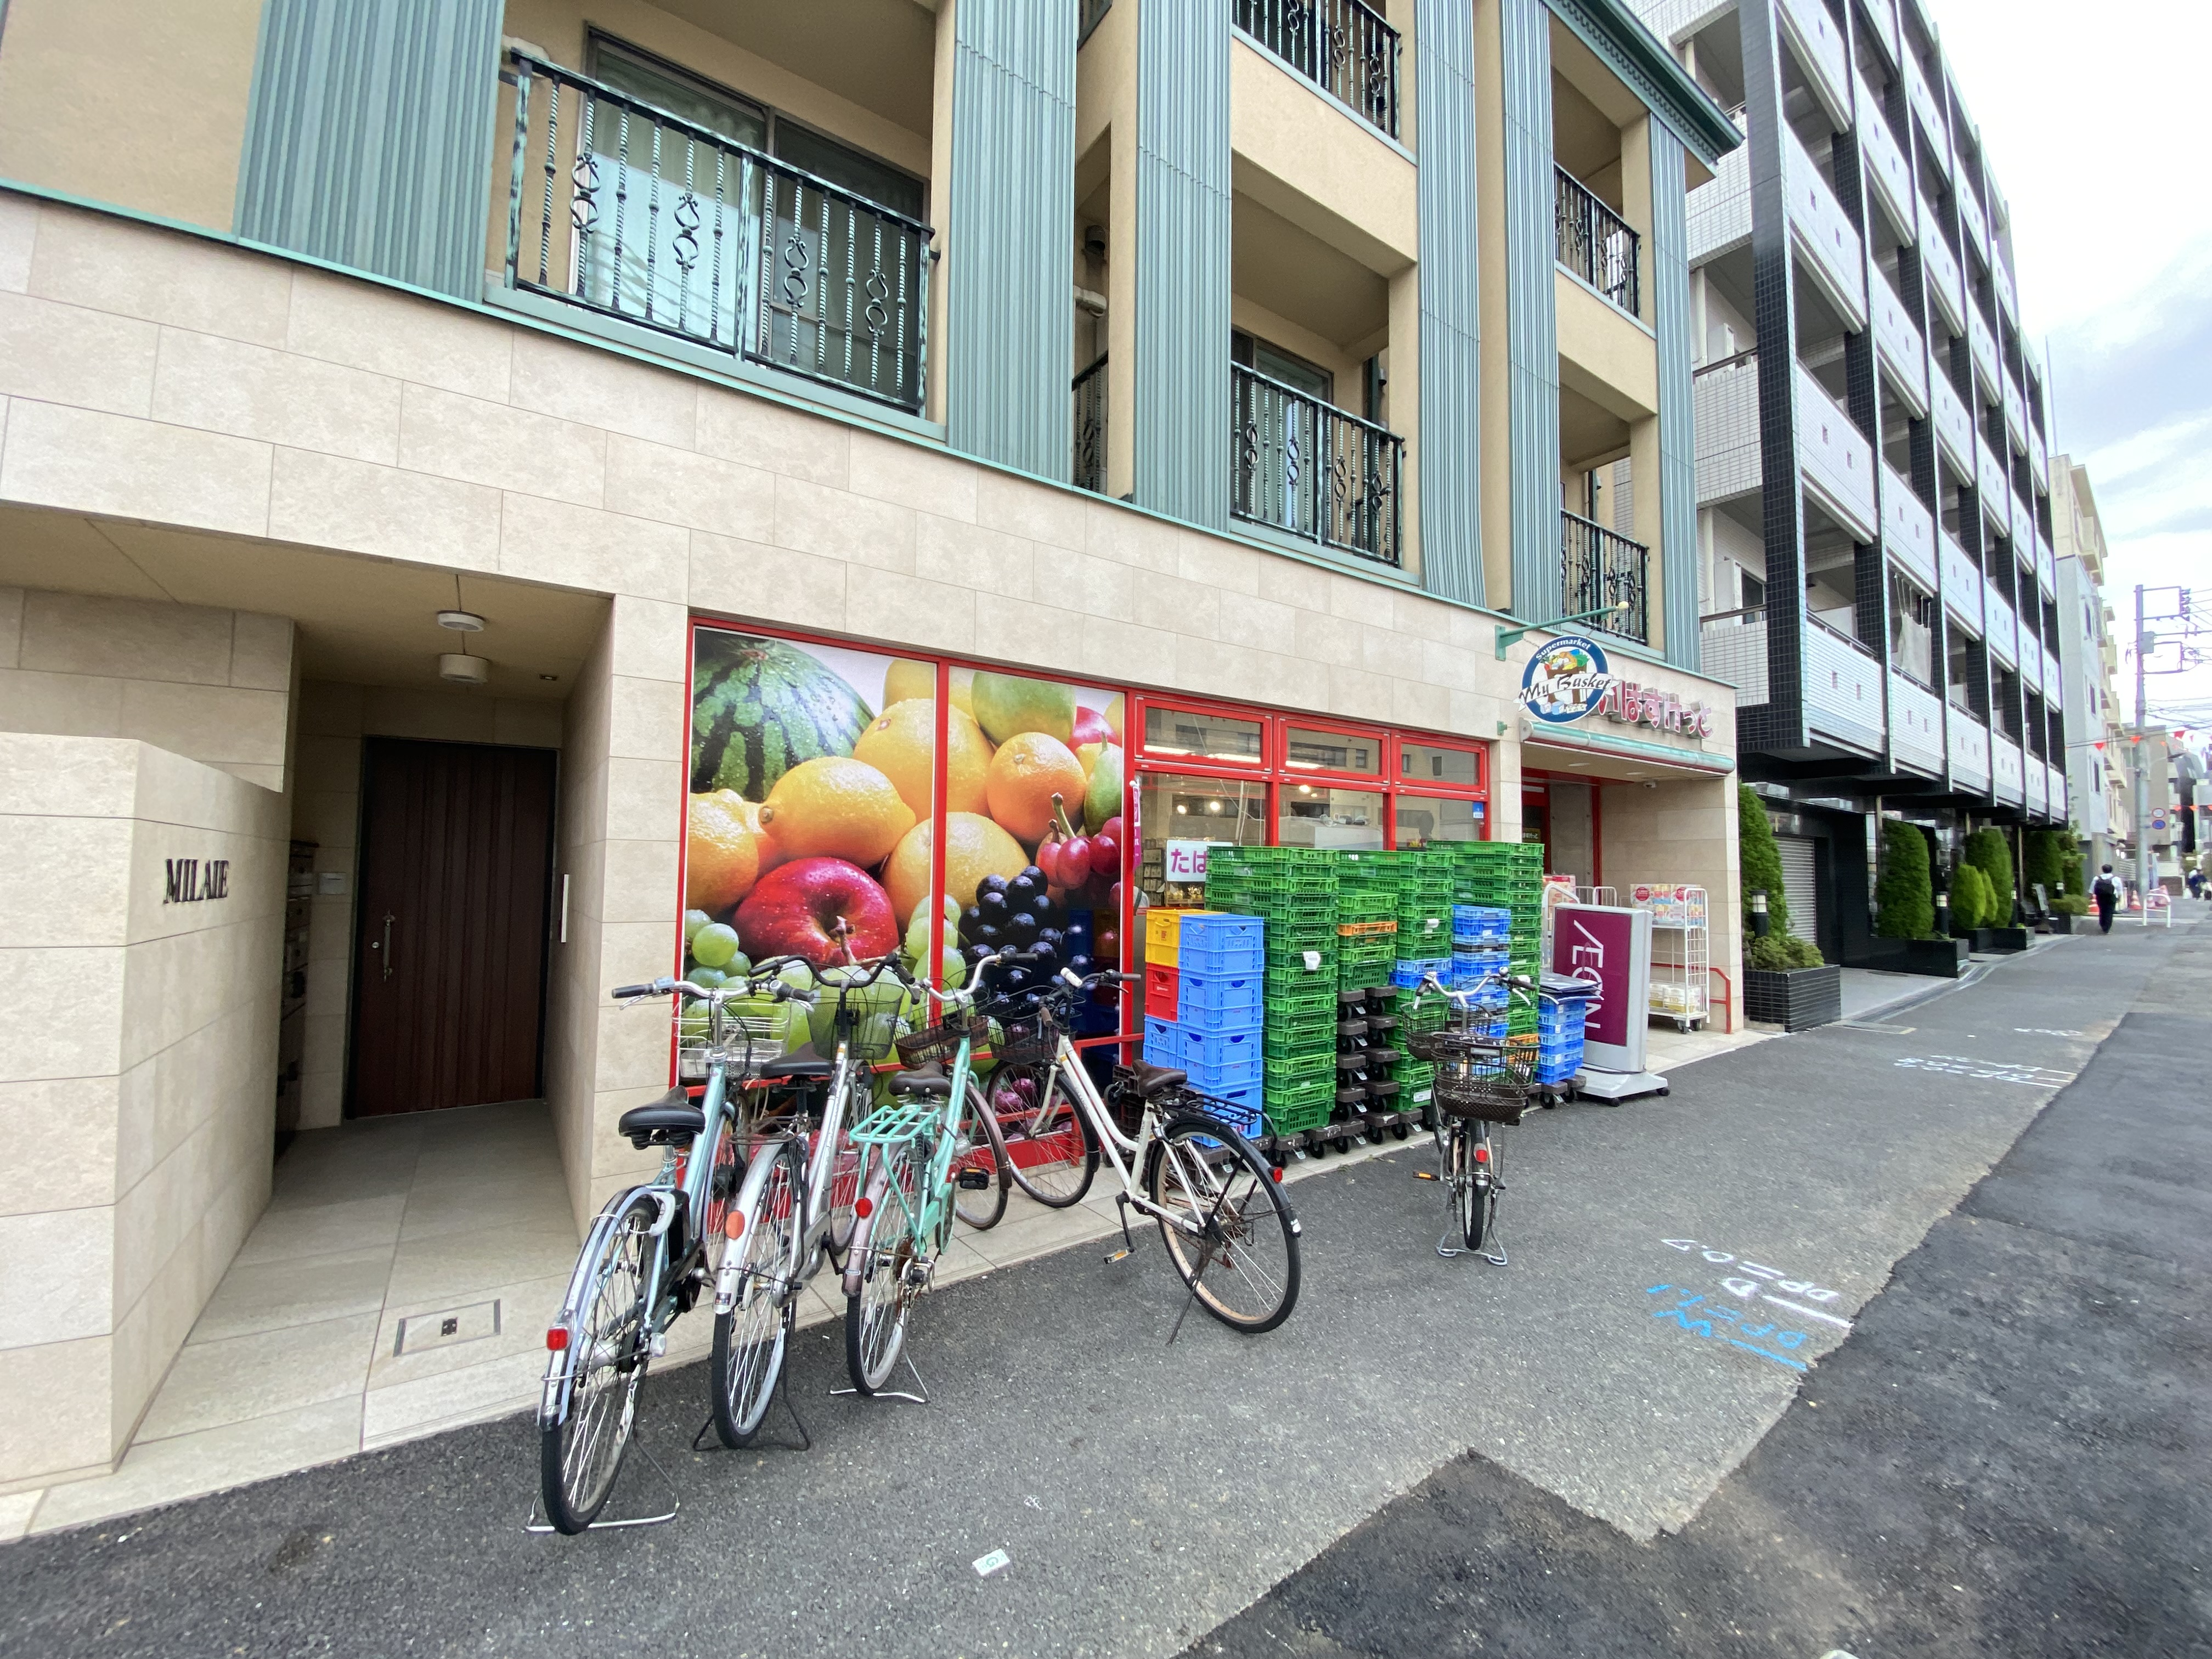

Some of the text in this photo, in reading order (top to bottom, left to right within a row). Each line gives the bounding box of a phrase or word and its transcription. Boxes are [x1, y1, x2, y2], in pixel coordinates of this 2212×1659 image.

[1536, 637, 1592, 660] Supermarket
[1519, 673, 1611, 703] My Basket
